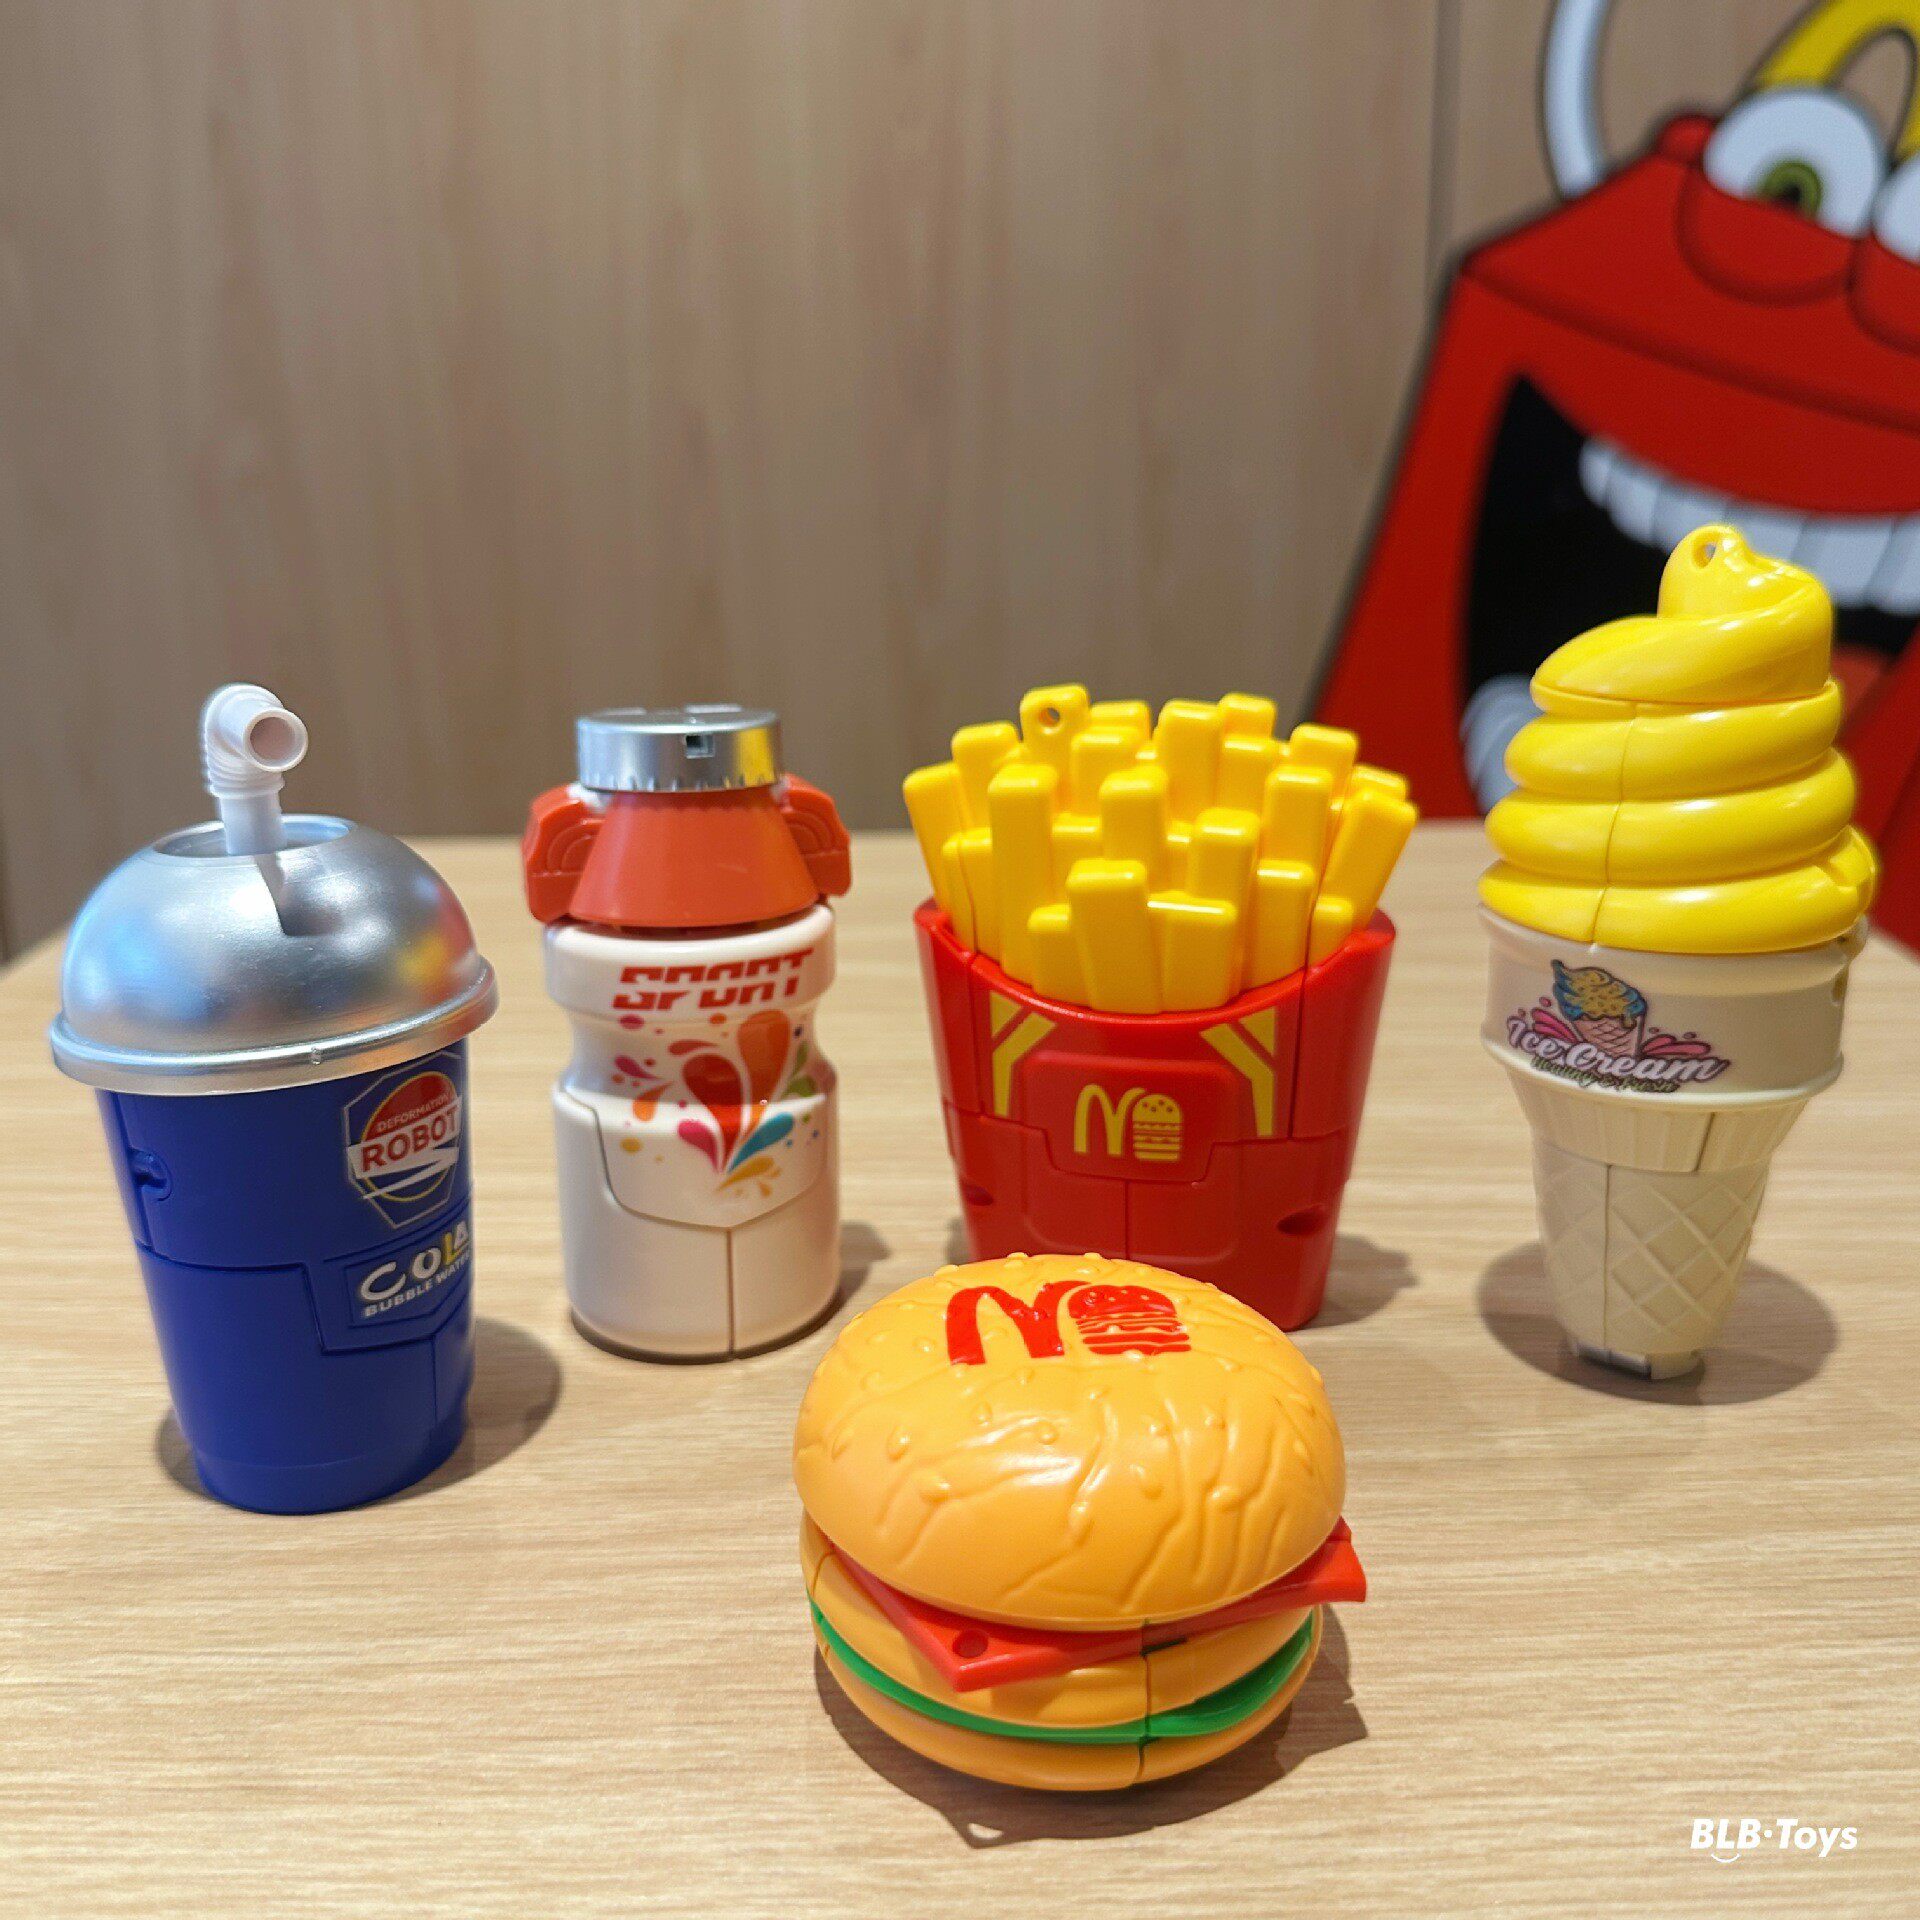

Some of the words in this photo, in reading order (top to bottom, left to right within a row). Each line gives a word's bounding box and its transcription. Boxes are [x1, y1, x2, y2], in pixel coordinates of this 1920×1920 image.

[612, 947, 815, 1011] SPORT
[1507, 1017, 1567, 1065] Ice
[1565, 1042, 1731, 1084] Cream
[361, 1106, 459, 1173] ROBOT
[361, 1221, 468, 1300] COLA
[364, 1279, 433, 1317] BUBBLE
